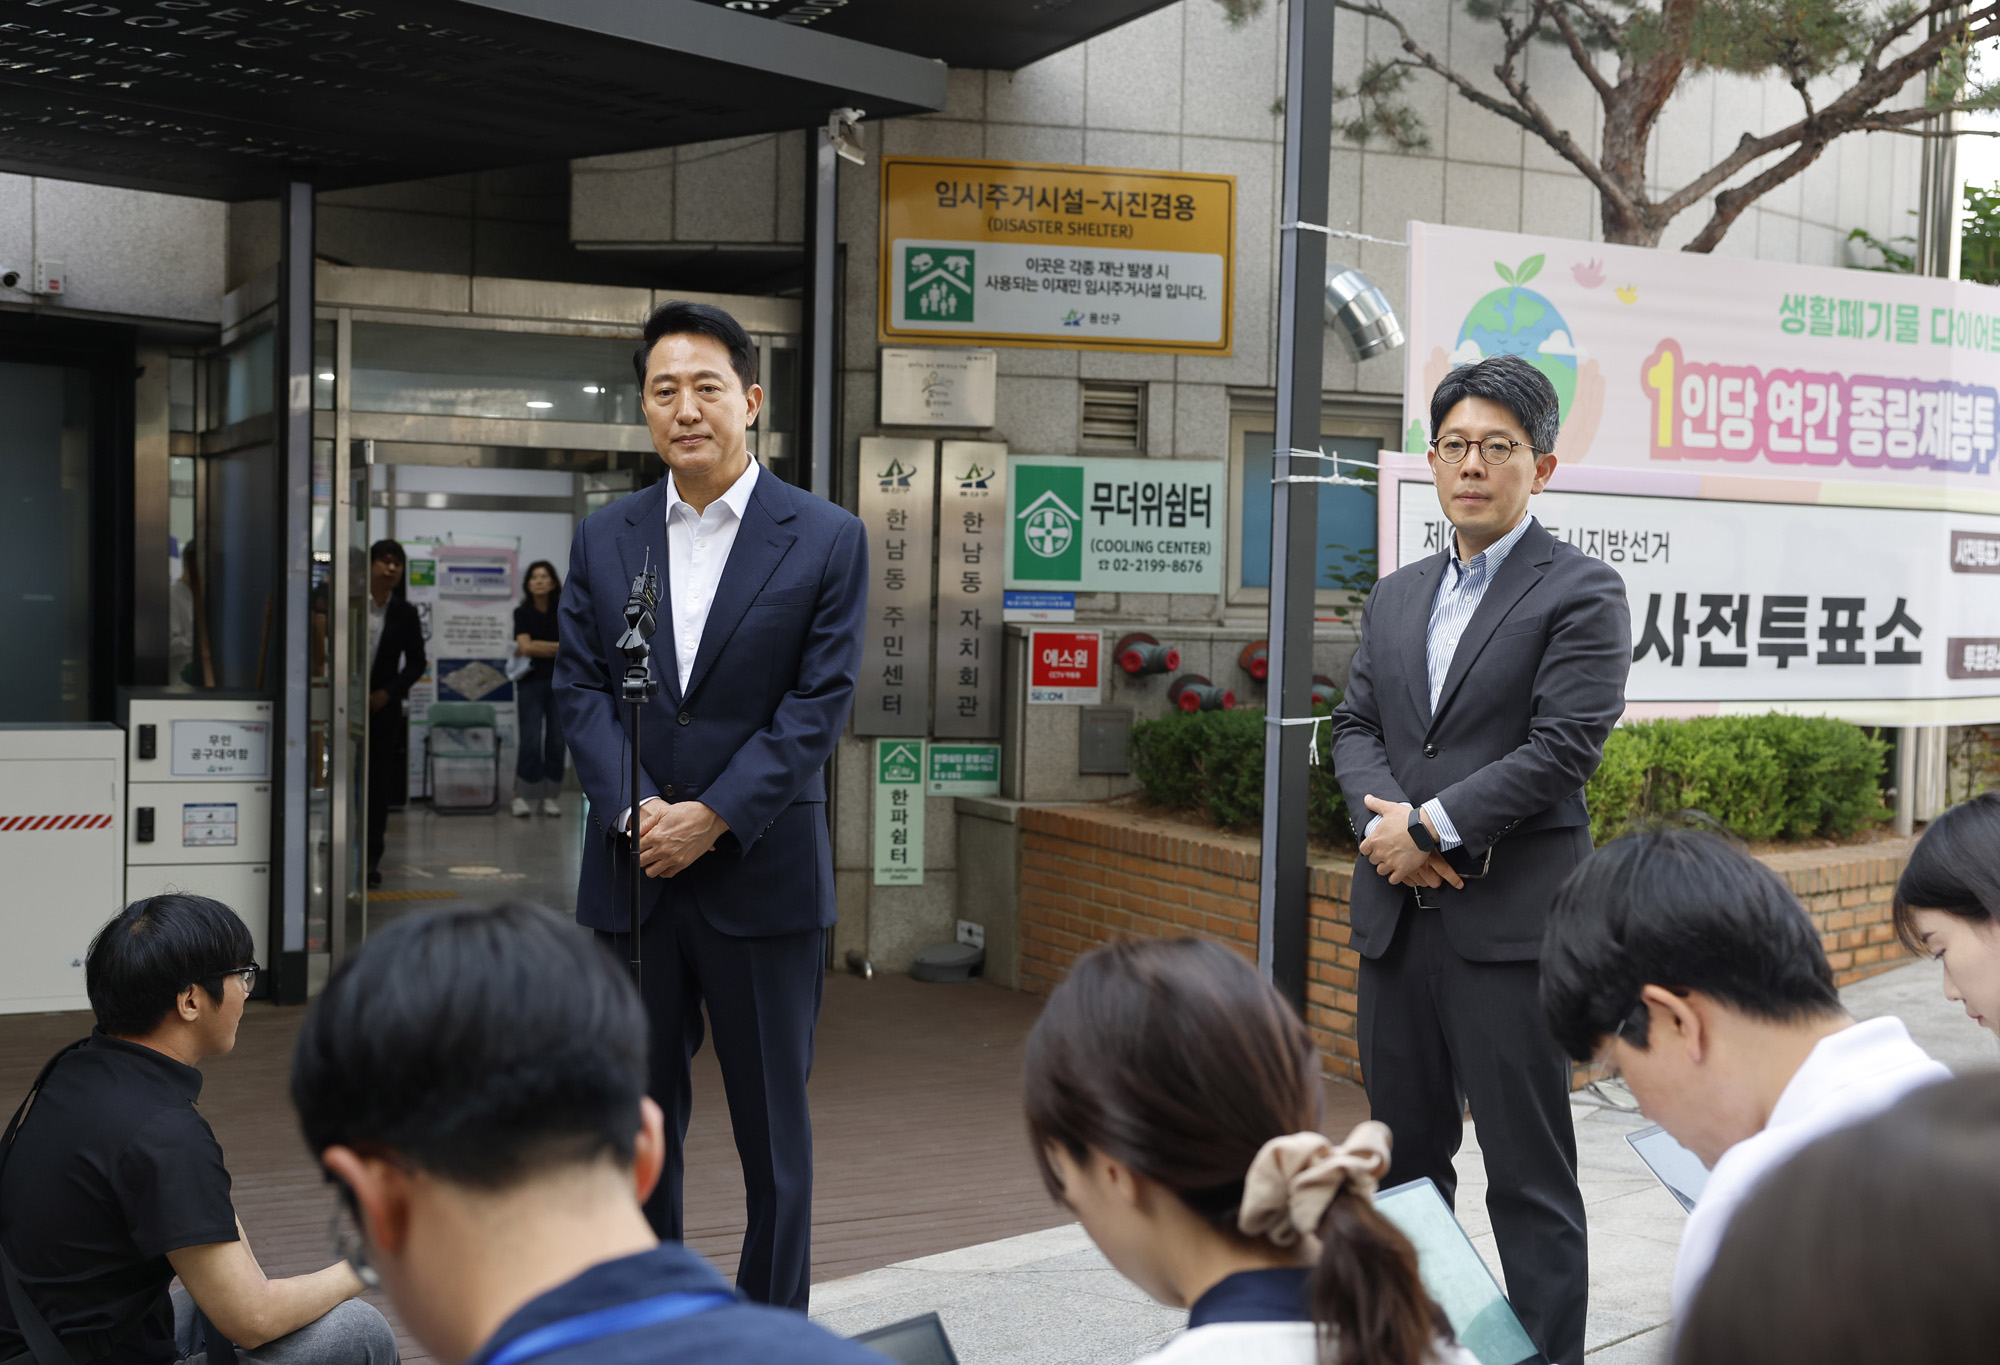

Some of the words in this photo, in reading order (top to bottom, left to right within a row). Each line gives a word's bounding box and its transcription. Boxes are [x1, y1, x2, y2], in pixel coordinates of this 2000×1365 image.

[935, 181, 1197, 221] 임시주거시설-지진겸용
[987, 217, 1063, 235] (DISASTER
[1068, 222, 1134, 239] SHELTER)
[985, 275, 1038, 293] 사용되는
[1041, 278, 1082, 296] 이재민
[1085, 279, 1162, 299] 임시주거시설
[1165, 283, 1207, 300] 입니다.
[1025, 257, 1065, 275] 이곳은
[1069, 259, 1095, 276] 각종
[1097, 261, 1125, 278] 재난
[1127, 262, 1154, 278] 발생
[1156, 263, 1170, 279] 시
[1089, 311, 1121, 326] 용산구
[1780, 293, 1920, 345] 생활폐기물
[1648, 350, 1759, 451] 1인당
[1766, 379, 1843, 455] 연간
[1848, 383, 1995, 464] 종량제봉투
[1090, 481, 1212, 529] 무더위쉼터
[884, 508, 908, 591] 한남동
[961, 511, 985, 594] 한남동
[1090, 538, 1154, 554] (COOLING
[1157, 540, 1212, 555] CENTER)
[1113, 558, 1204, 573] 02-2199-8676
[1632, 593, 1922, 669] 사전투표소
[882, 606, 905, 716] 주민센터
[957, 608, 982, 718] 자치회관
[1042, 648, 1088, 669] 에스원
[191, 748, 249, 761] 공구대여함
[208, 734, 232, 747] 무인
[890, 788, 908, 865] 한파쉼터
